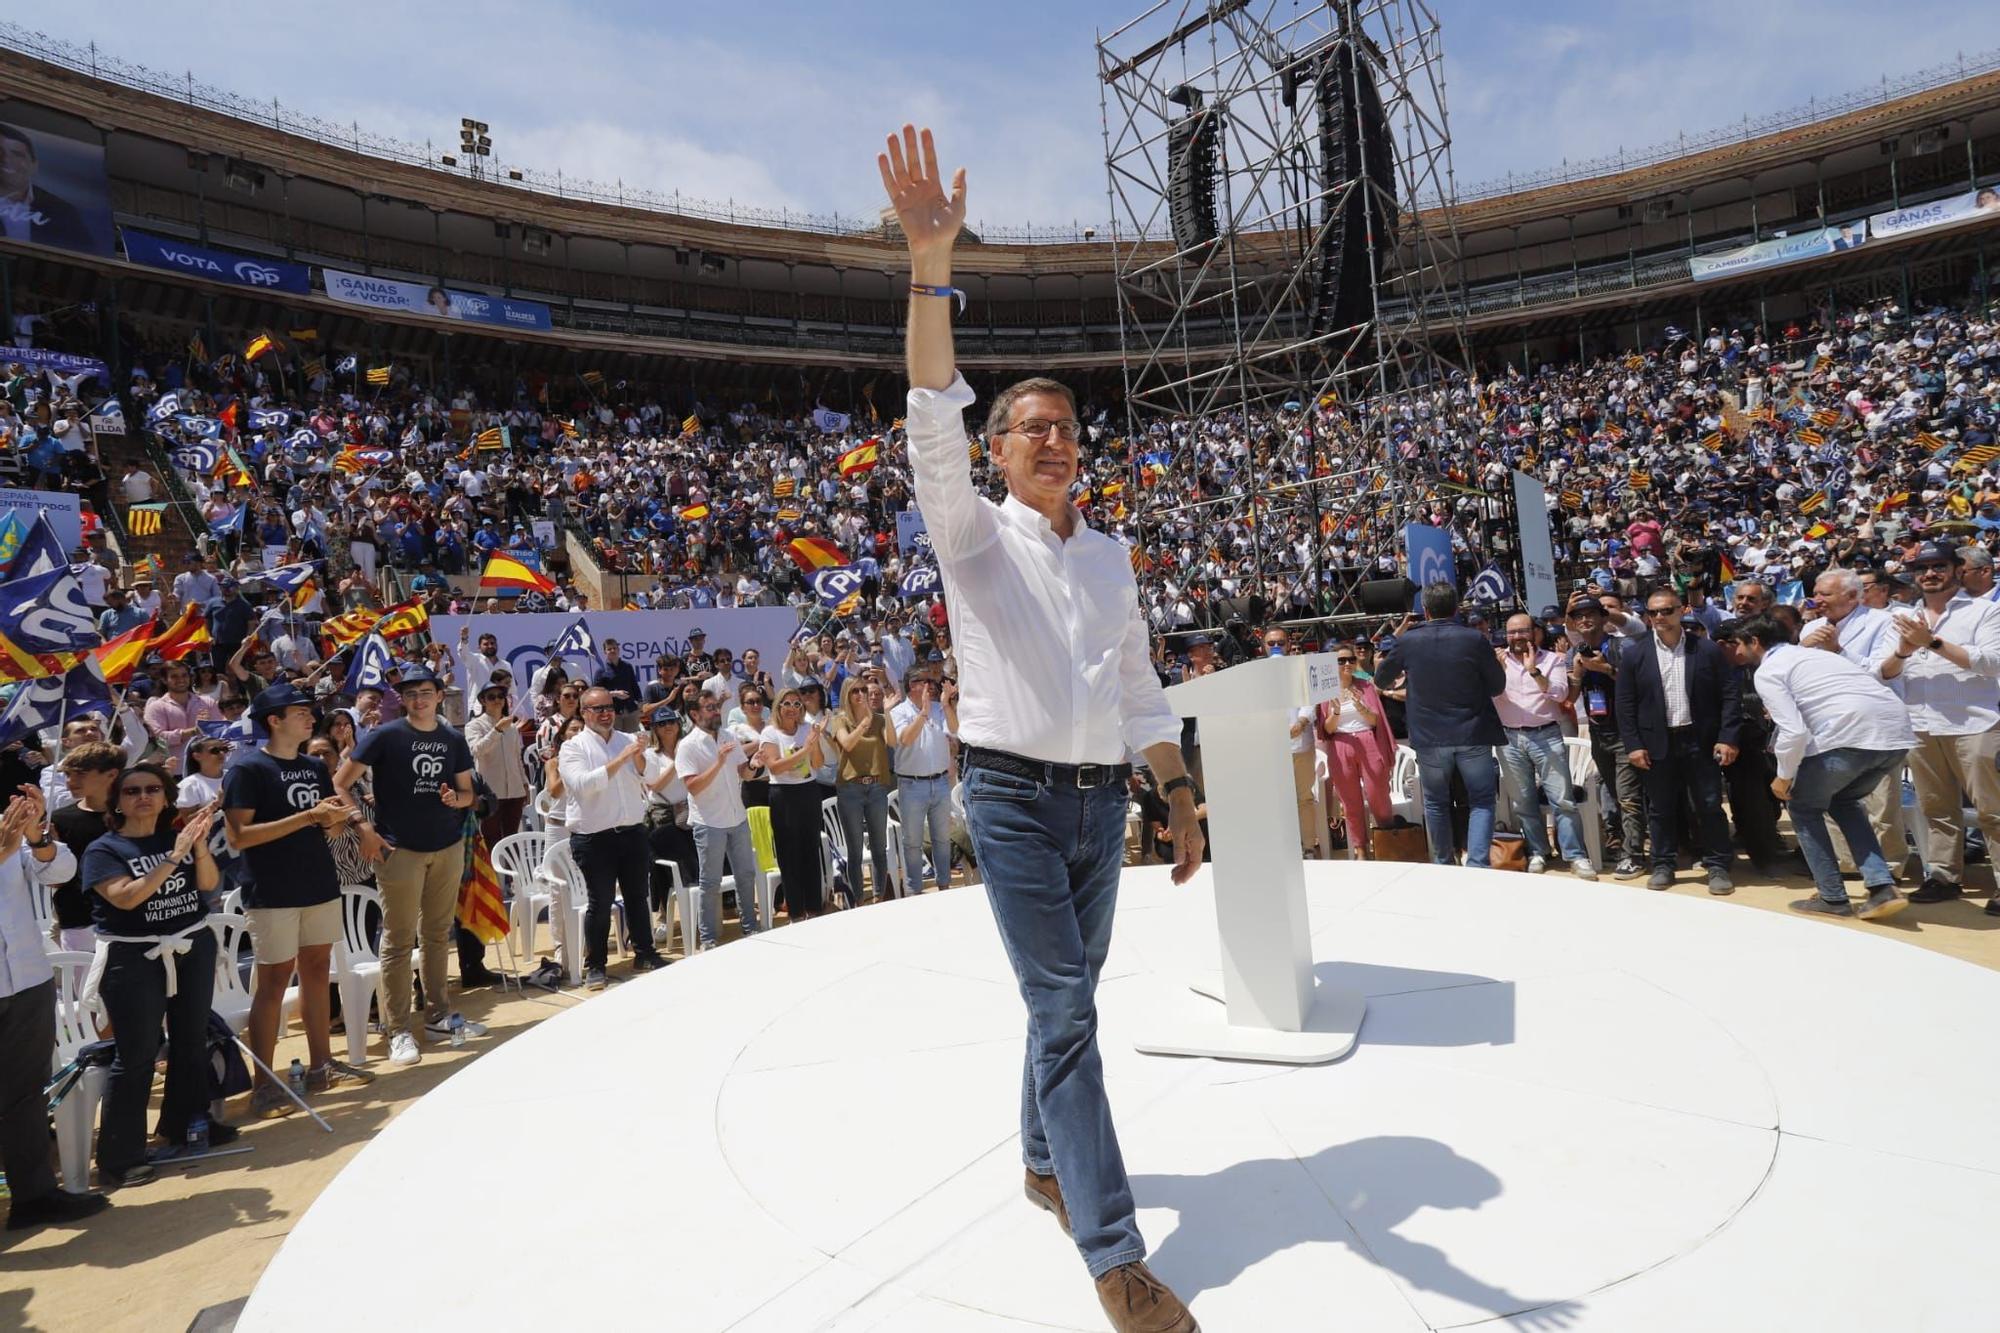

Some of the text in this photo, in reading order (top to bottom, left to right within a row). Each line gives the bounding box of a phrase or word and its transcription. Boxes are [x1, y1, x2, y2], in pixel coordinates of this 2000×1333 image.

[160, 248, 223, 273] VOTA
[336, 278, 398, 296] ¡GANAS
[360, 291, 410, 306] VOTAR!
[95, 425, 122, 434] ELDA
[36, 502, 72, 511] TODOS
[619, 637, 693, 660] SPAÑA
[412, 740, 448, 753] EQUIPO
[281, 769, 318, 782] EQUIPO
[147, 889, 199, 911] COMUNITAT
